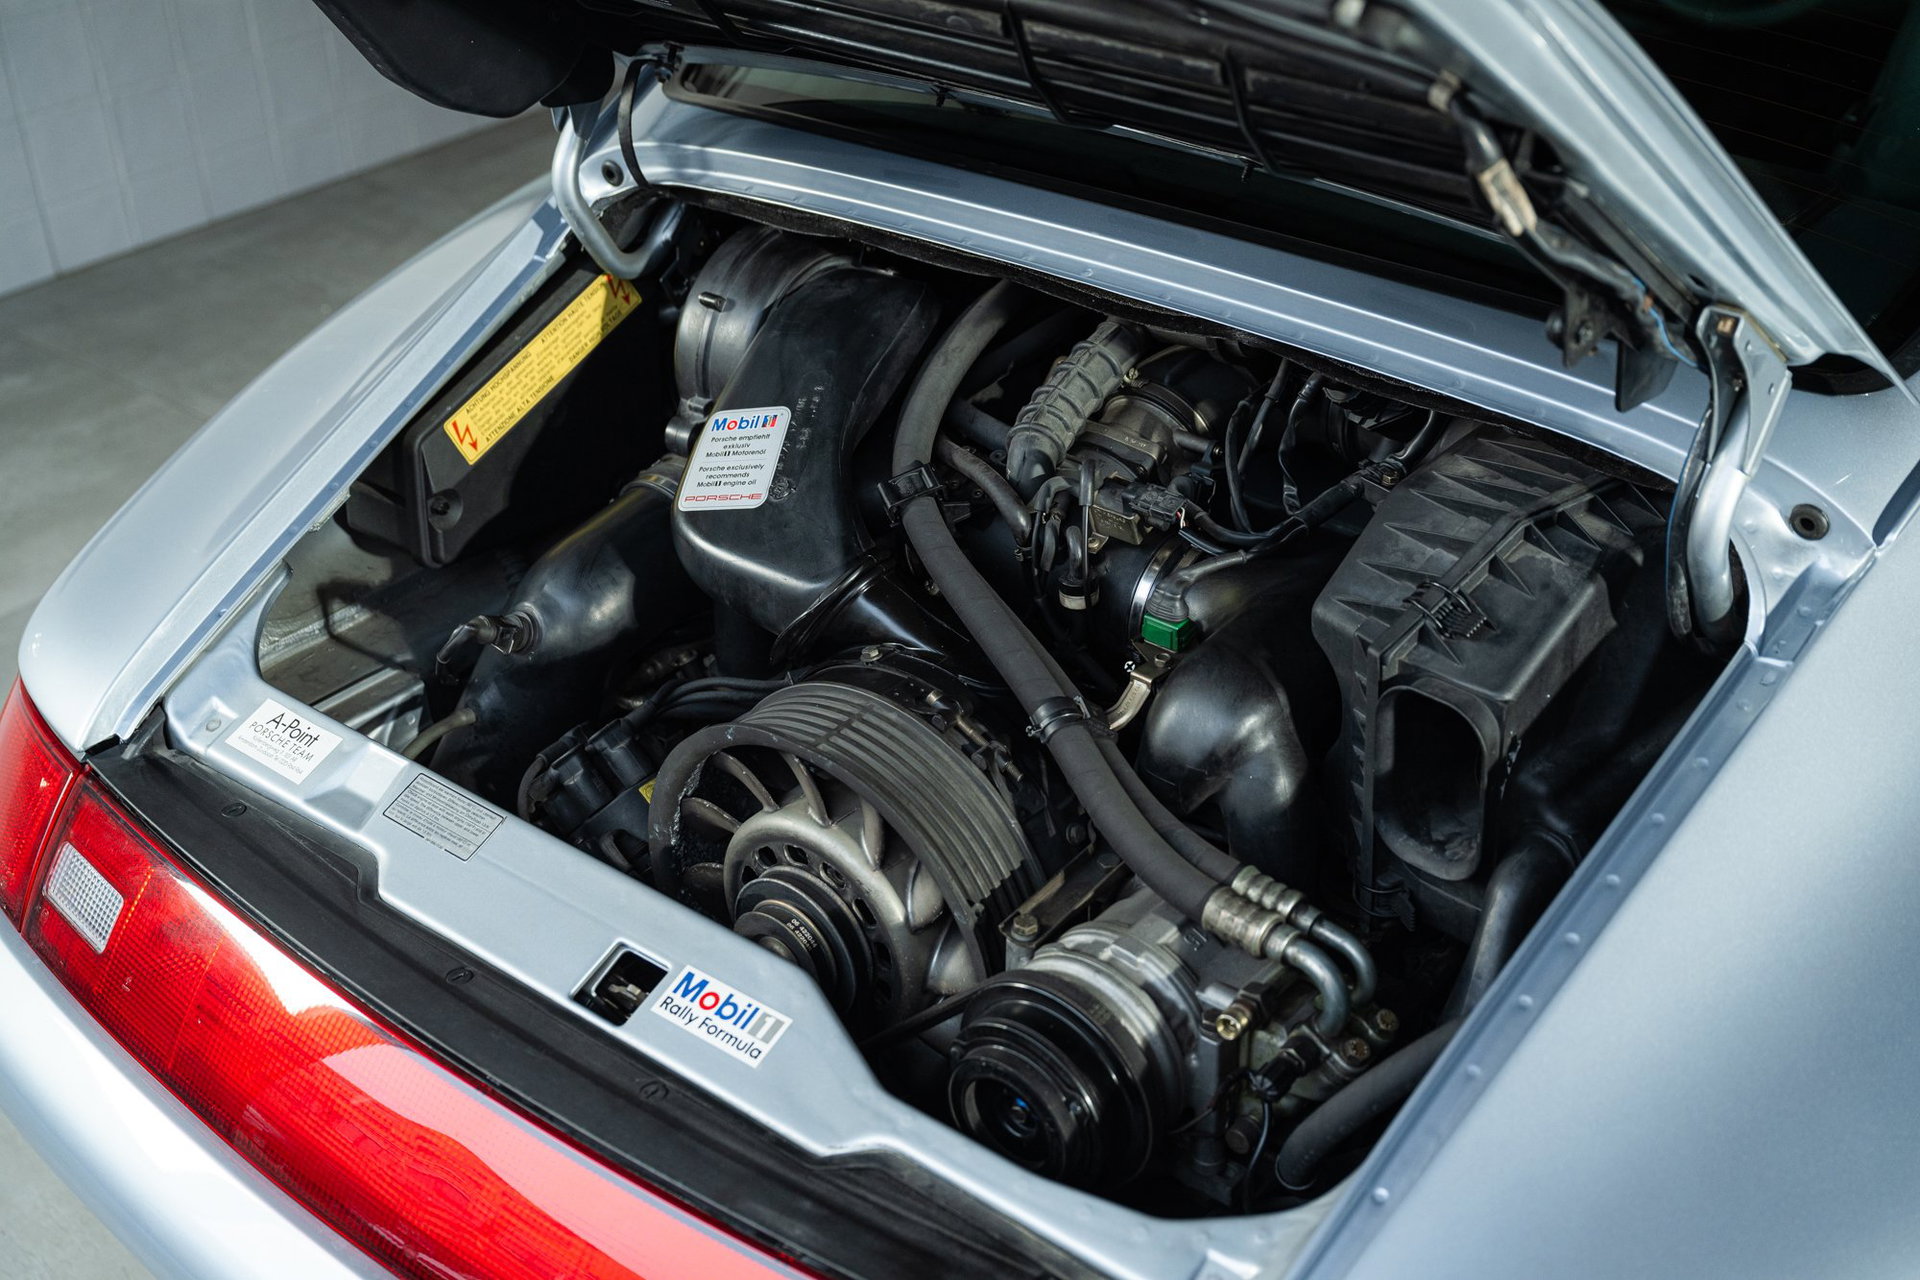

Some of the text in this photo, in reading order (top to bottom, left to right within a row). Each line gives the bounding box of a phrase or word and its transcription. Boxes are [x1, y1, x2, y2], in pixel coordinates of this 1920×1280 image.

[465, 391, 491, 414] ACHTUNG
[490, 352, 532, 391] HOCHSPANNUNG
[486, 375, 555, 443] ATTENZIONE ALTA TENSIONE
[738, 434, 771, 442] empfiehlt
[684, 493, 764, 503] PORSCHE
[248, 721, 291, 749] PORSCHE
[289, 742, 314, 762] TEAM
[266, 711, 321, 748] A-Point
[659, 996, 763, 1060] Rally Formula
